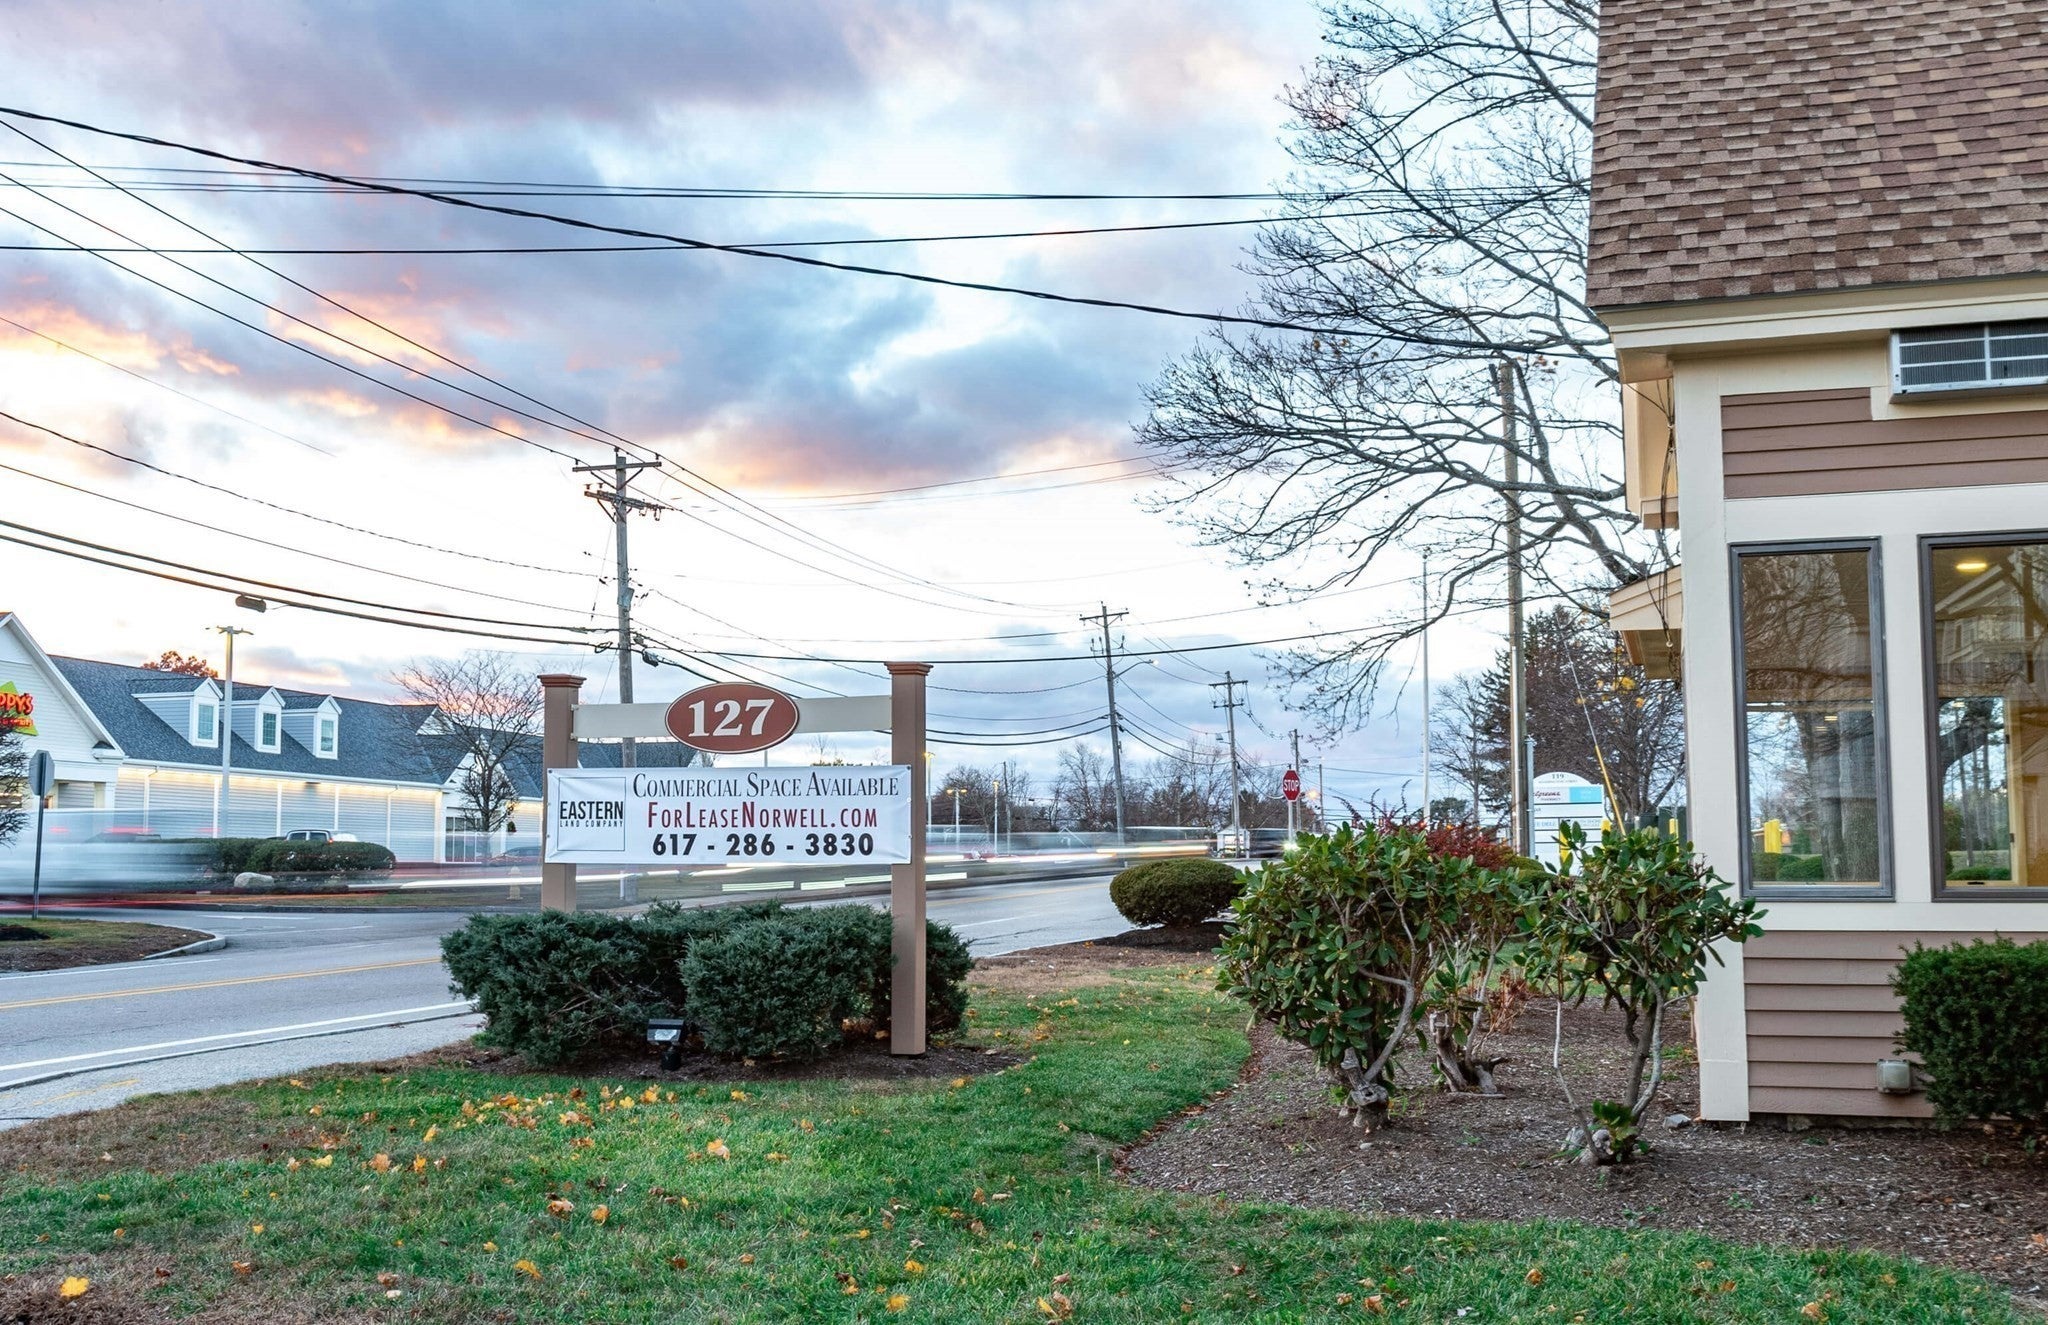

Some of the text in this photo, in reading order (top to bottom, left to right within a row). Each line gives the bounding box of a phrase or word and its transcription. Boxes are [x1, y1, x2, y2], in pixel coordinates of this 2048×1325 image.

[688, 699, 775, 737] 127
[1283, 779, 1299, 791] STOP
[560, 801, 624, 820] EASTERN
[560, 820, 623, 828] LAND COMPANY
[652, 833, 697, 856] 617
[726, 833, 775, 856] 286
[805, 832, 874, 856] 3830
